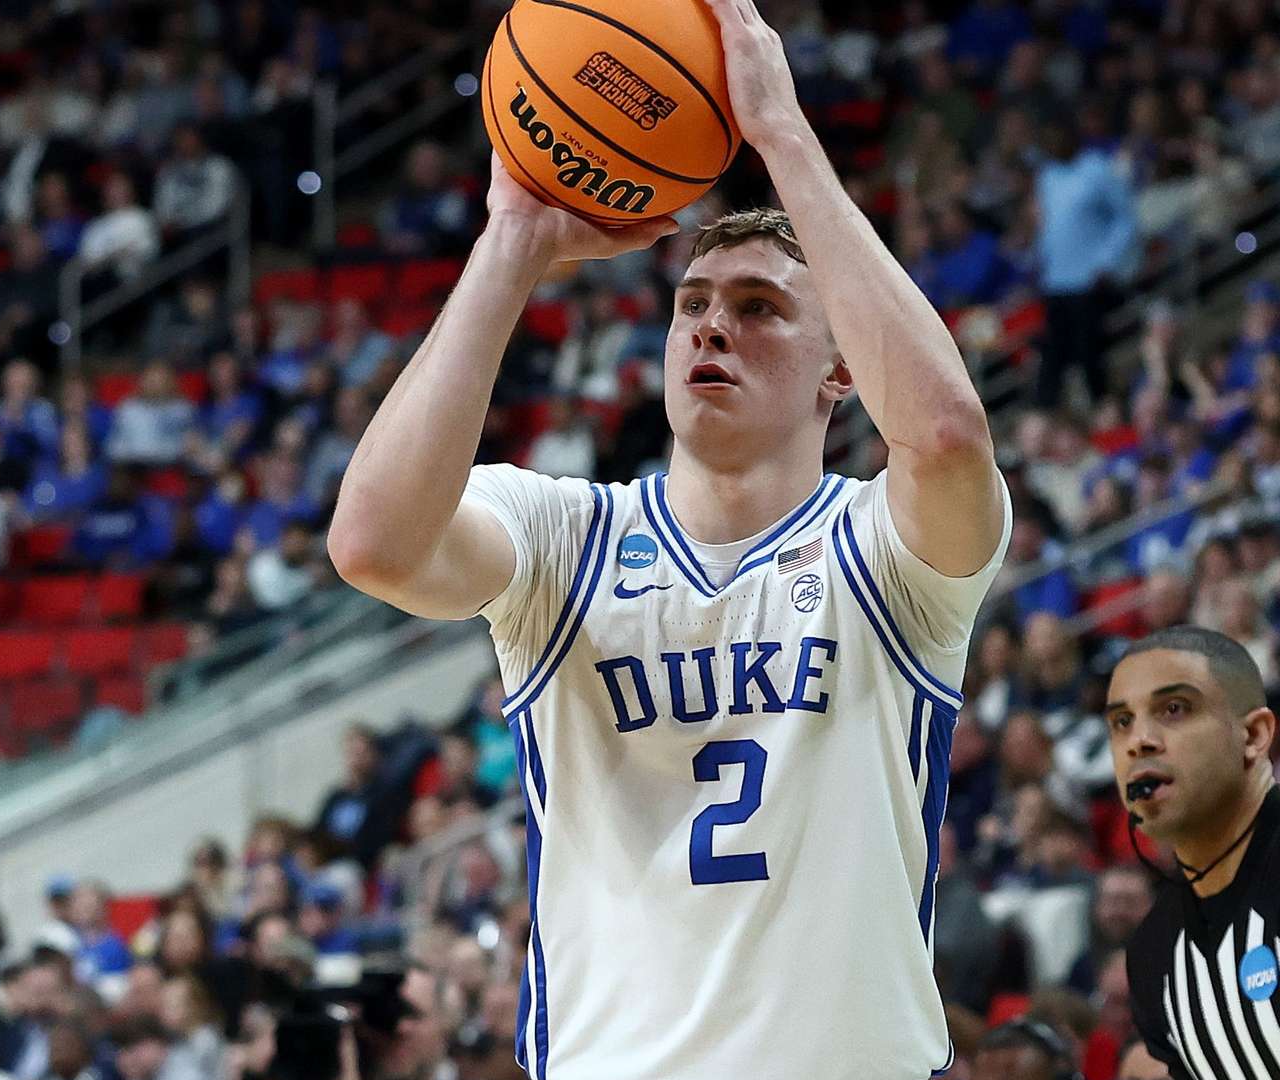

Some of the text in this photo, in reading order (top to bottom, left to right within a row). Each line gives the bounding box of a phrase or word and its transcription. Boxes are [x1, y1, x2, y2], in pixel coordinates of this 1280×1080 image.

[588, 53, 651, 104] MADNESS
[598, 80, 647, 120] MARCH
[509, 86, 655, 213] Wilson
[620, 550, 656, 561] NCAA
[594, 637, 838, 732] DUKE
[689, 738, 770, 886] 2
